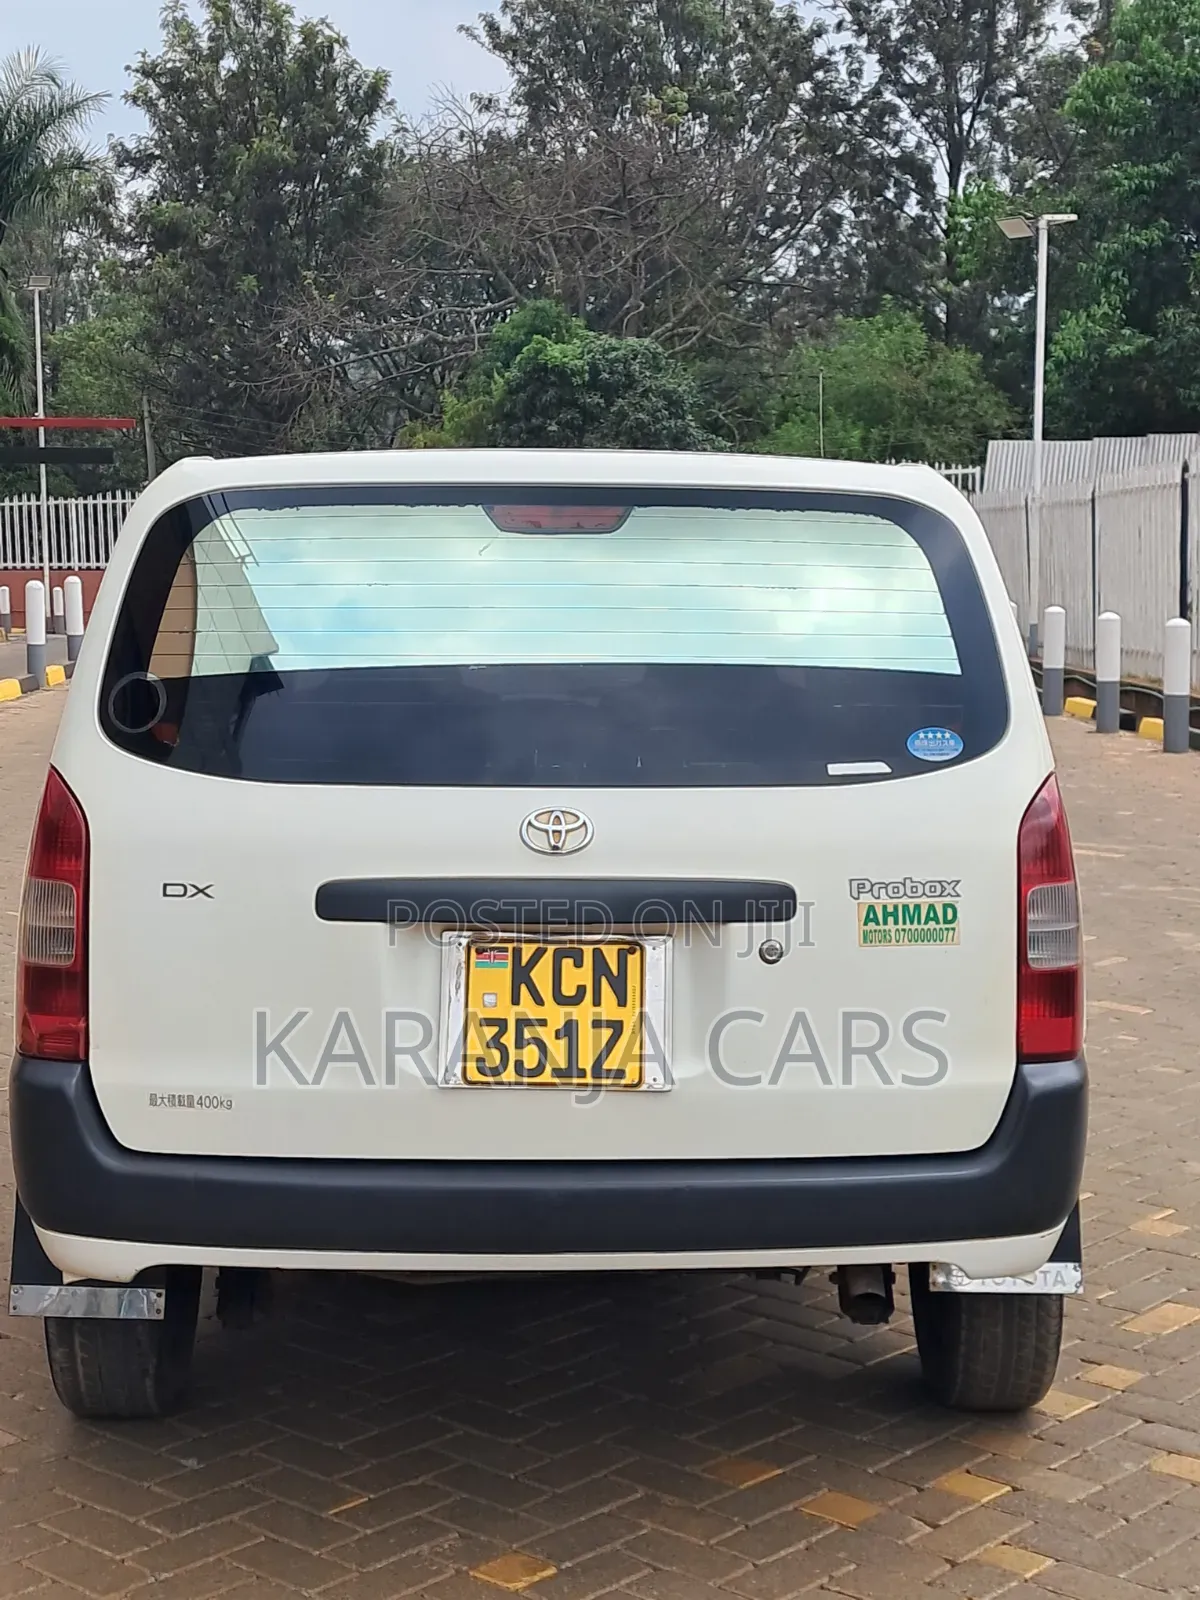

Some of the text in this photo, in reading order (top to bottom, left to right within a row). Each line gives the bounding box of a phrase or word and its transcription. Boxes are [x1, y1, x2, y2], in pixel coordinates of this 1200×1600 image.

[162, 882, 215, 899] DX
[848, 877, 962, 901] Probox
[862, 903, 958, 926] AHMAD
[862, 927, 956, 944] MOTORS 0700000077
[510, 946, 628, 1008] KCN
[475, 1018, 627, 1079] 351Z
